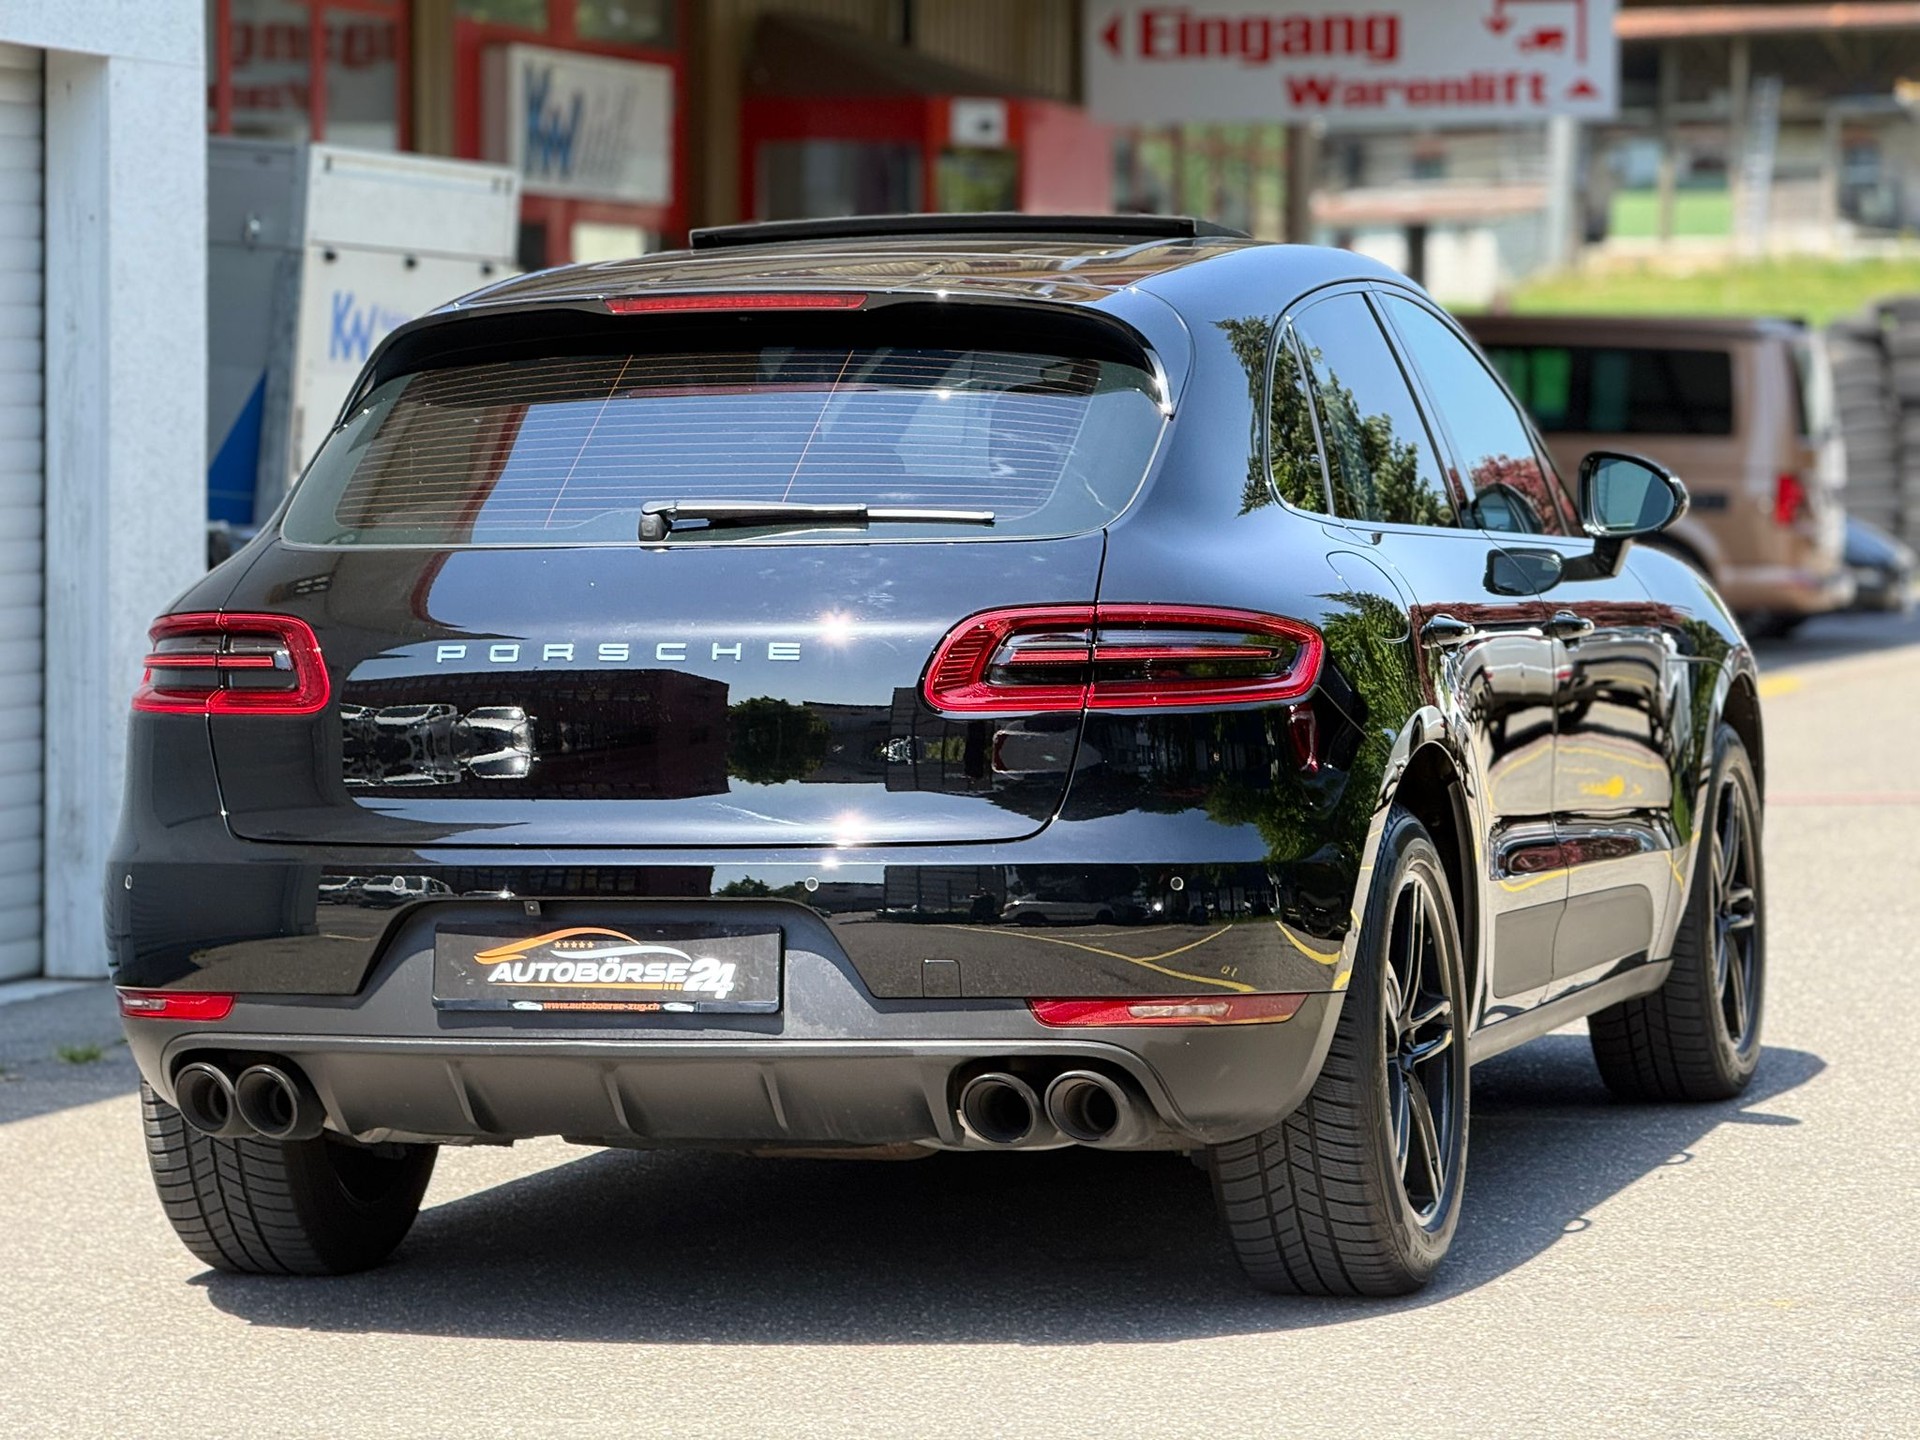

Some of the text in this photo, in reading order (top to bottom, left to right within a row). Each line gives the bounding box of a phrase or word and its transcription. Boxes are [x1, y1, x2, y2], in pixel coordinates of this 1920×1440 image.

[1137, 9, 1400, 64] Eingang
[1284, 70, 1547, 109] Warenlift
[436, 642, 801, 663] PORSCHE
[543, 1001, 660, 1011] www.autoboerse-zug.ch
